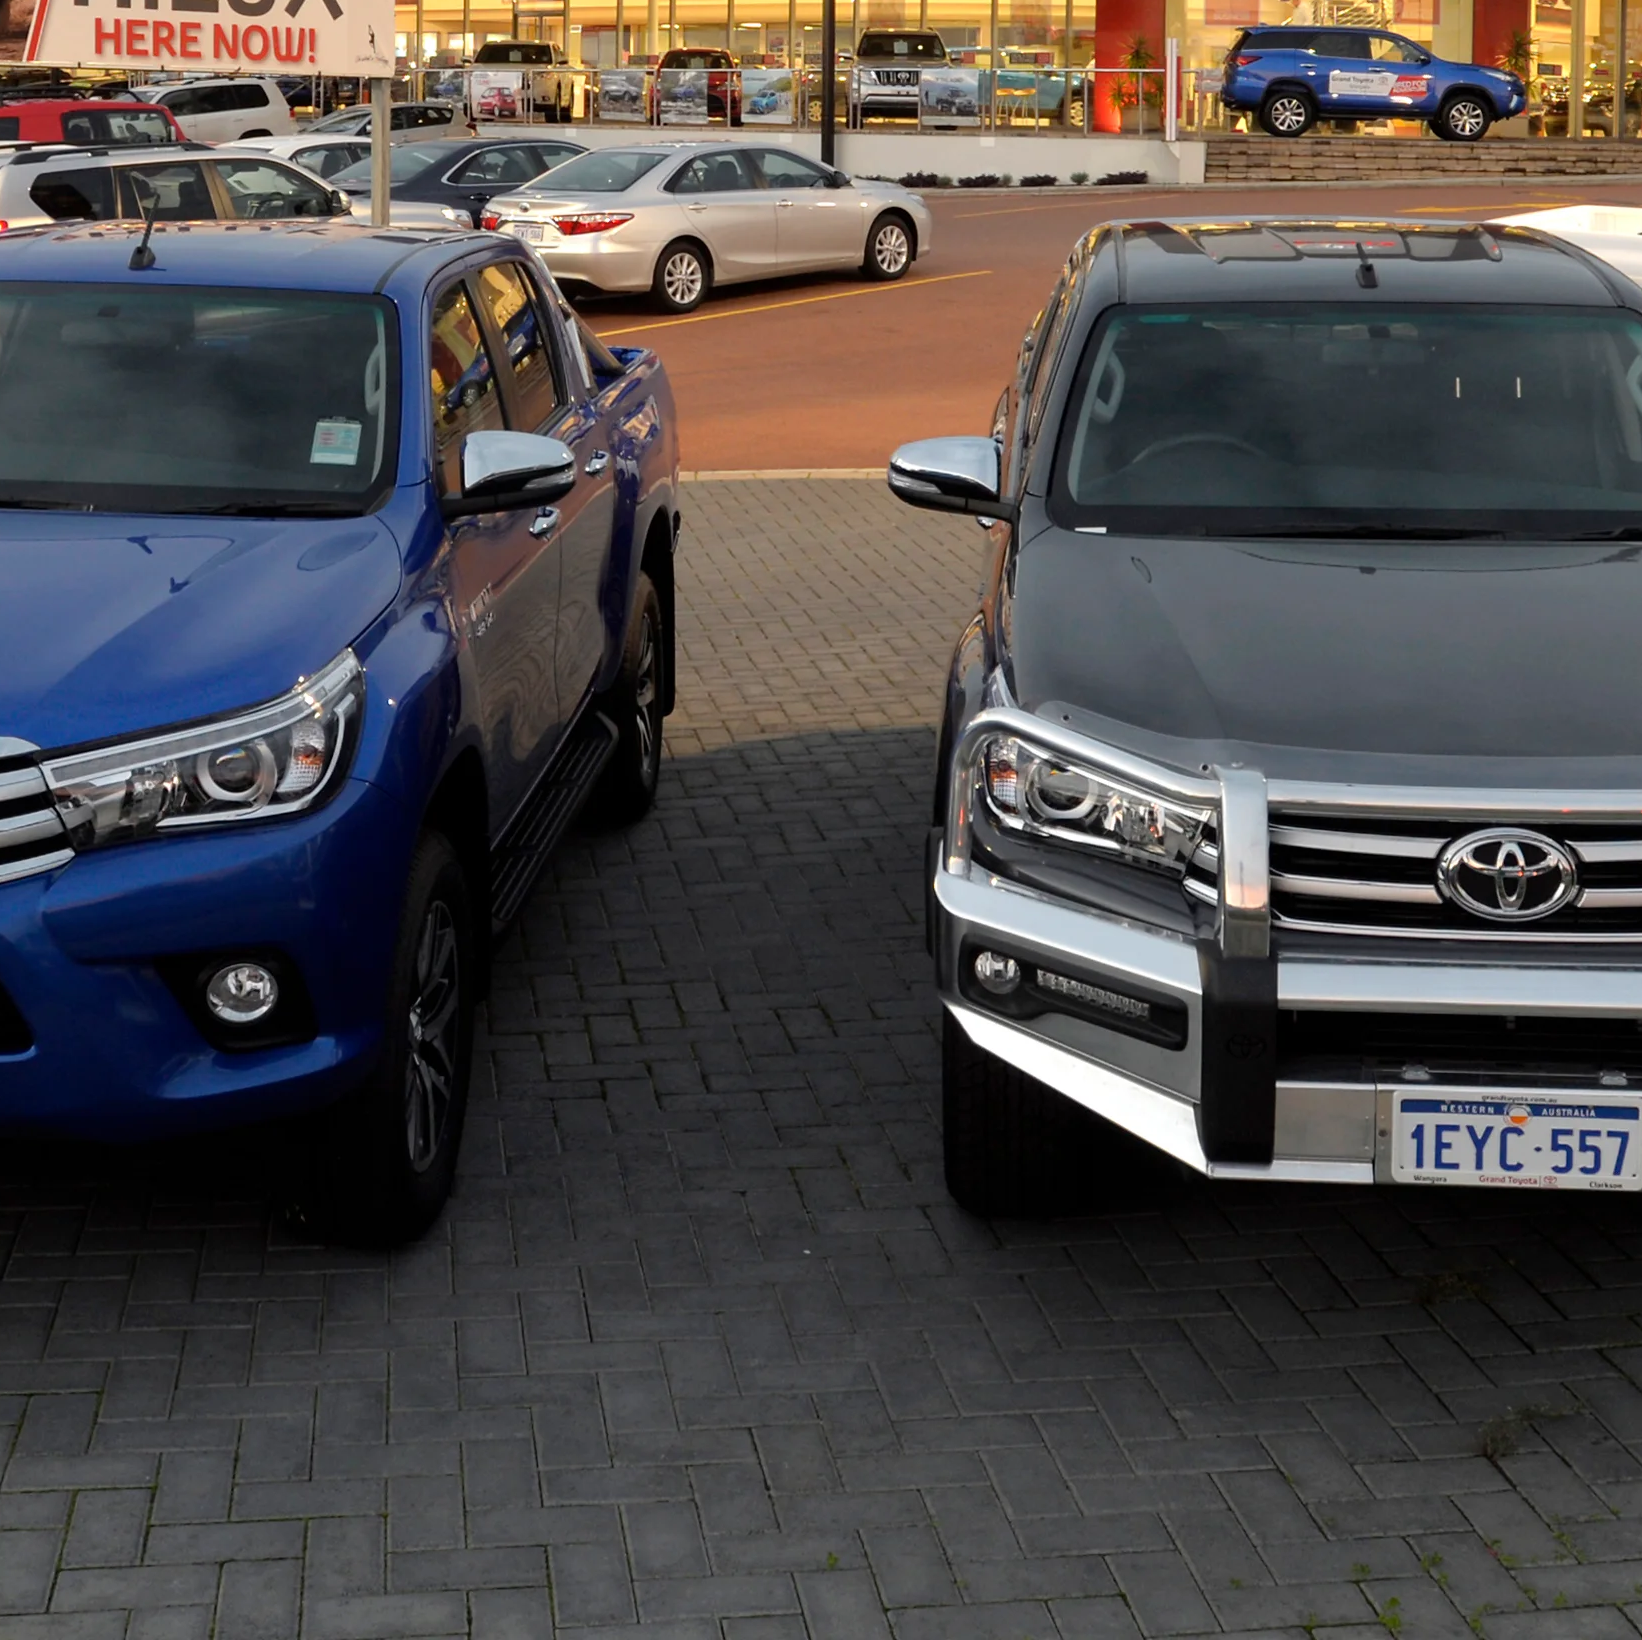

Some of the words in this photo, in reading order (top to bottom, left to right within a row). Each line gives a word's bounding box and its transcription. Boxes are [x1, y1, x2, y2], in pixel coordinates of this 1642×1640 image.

[94, 17, 203, 59] HERE
[213, 23, 316, 63] NOW!
[1482, 1094, 1558, 1104] grandtoyota.com.au
[1441, 1103, 1496, 1115] WESTERN
[1541, 1108, 1597, 1119] AUSTRALIA
[1413, 1174, 1448, 1184] Wangara
[1478, 1175, 1506, 1185] Grand
[1507, 1176, 1539, 1187] Toyota
[1589, 1181, 1624, 1189] Clarkson
